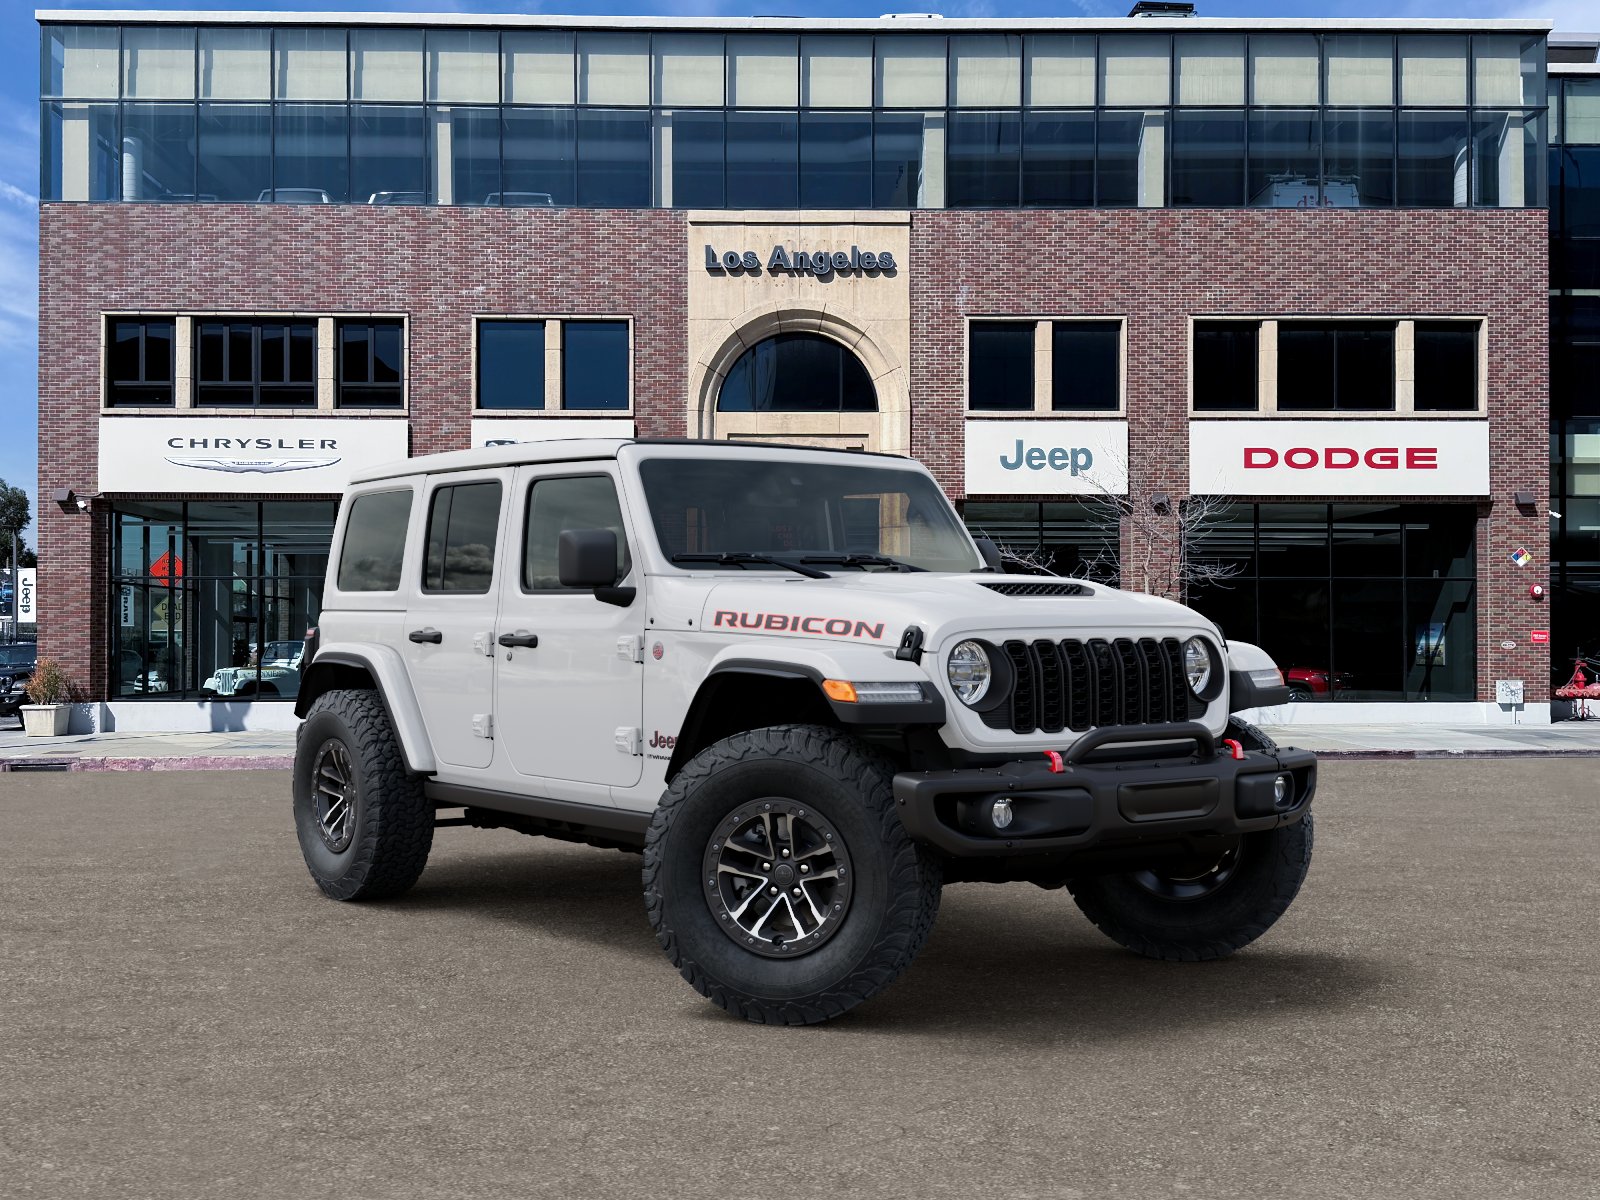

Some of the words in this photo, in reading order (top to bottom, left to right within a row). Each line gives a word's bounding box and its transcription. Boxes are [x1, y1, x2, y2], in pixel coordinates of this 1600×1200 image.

[1297, 195, 1334, 207] dih
[705, 245, 758, 269] Los
[767, 245, 894, 275] Angeles
[167, 437, 338, 449] CHRYSLER
[999, 439, 1093, 477] Jeep
[1243, 447, 1438, 469] DODGE
[20, 578, 33, 613] Jeep
[714, 610, 886, 640] RUBICON
[649, 730, 678, 749] Jee
